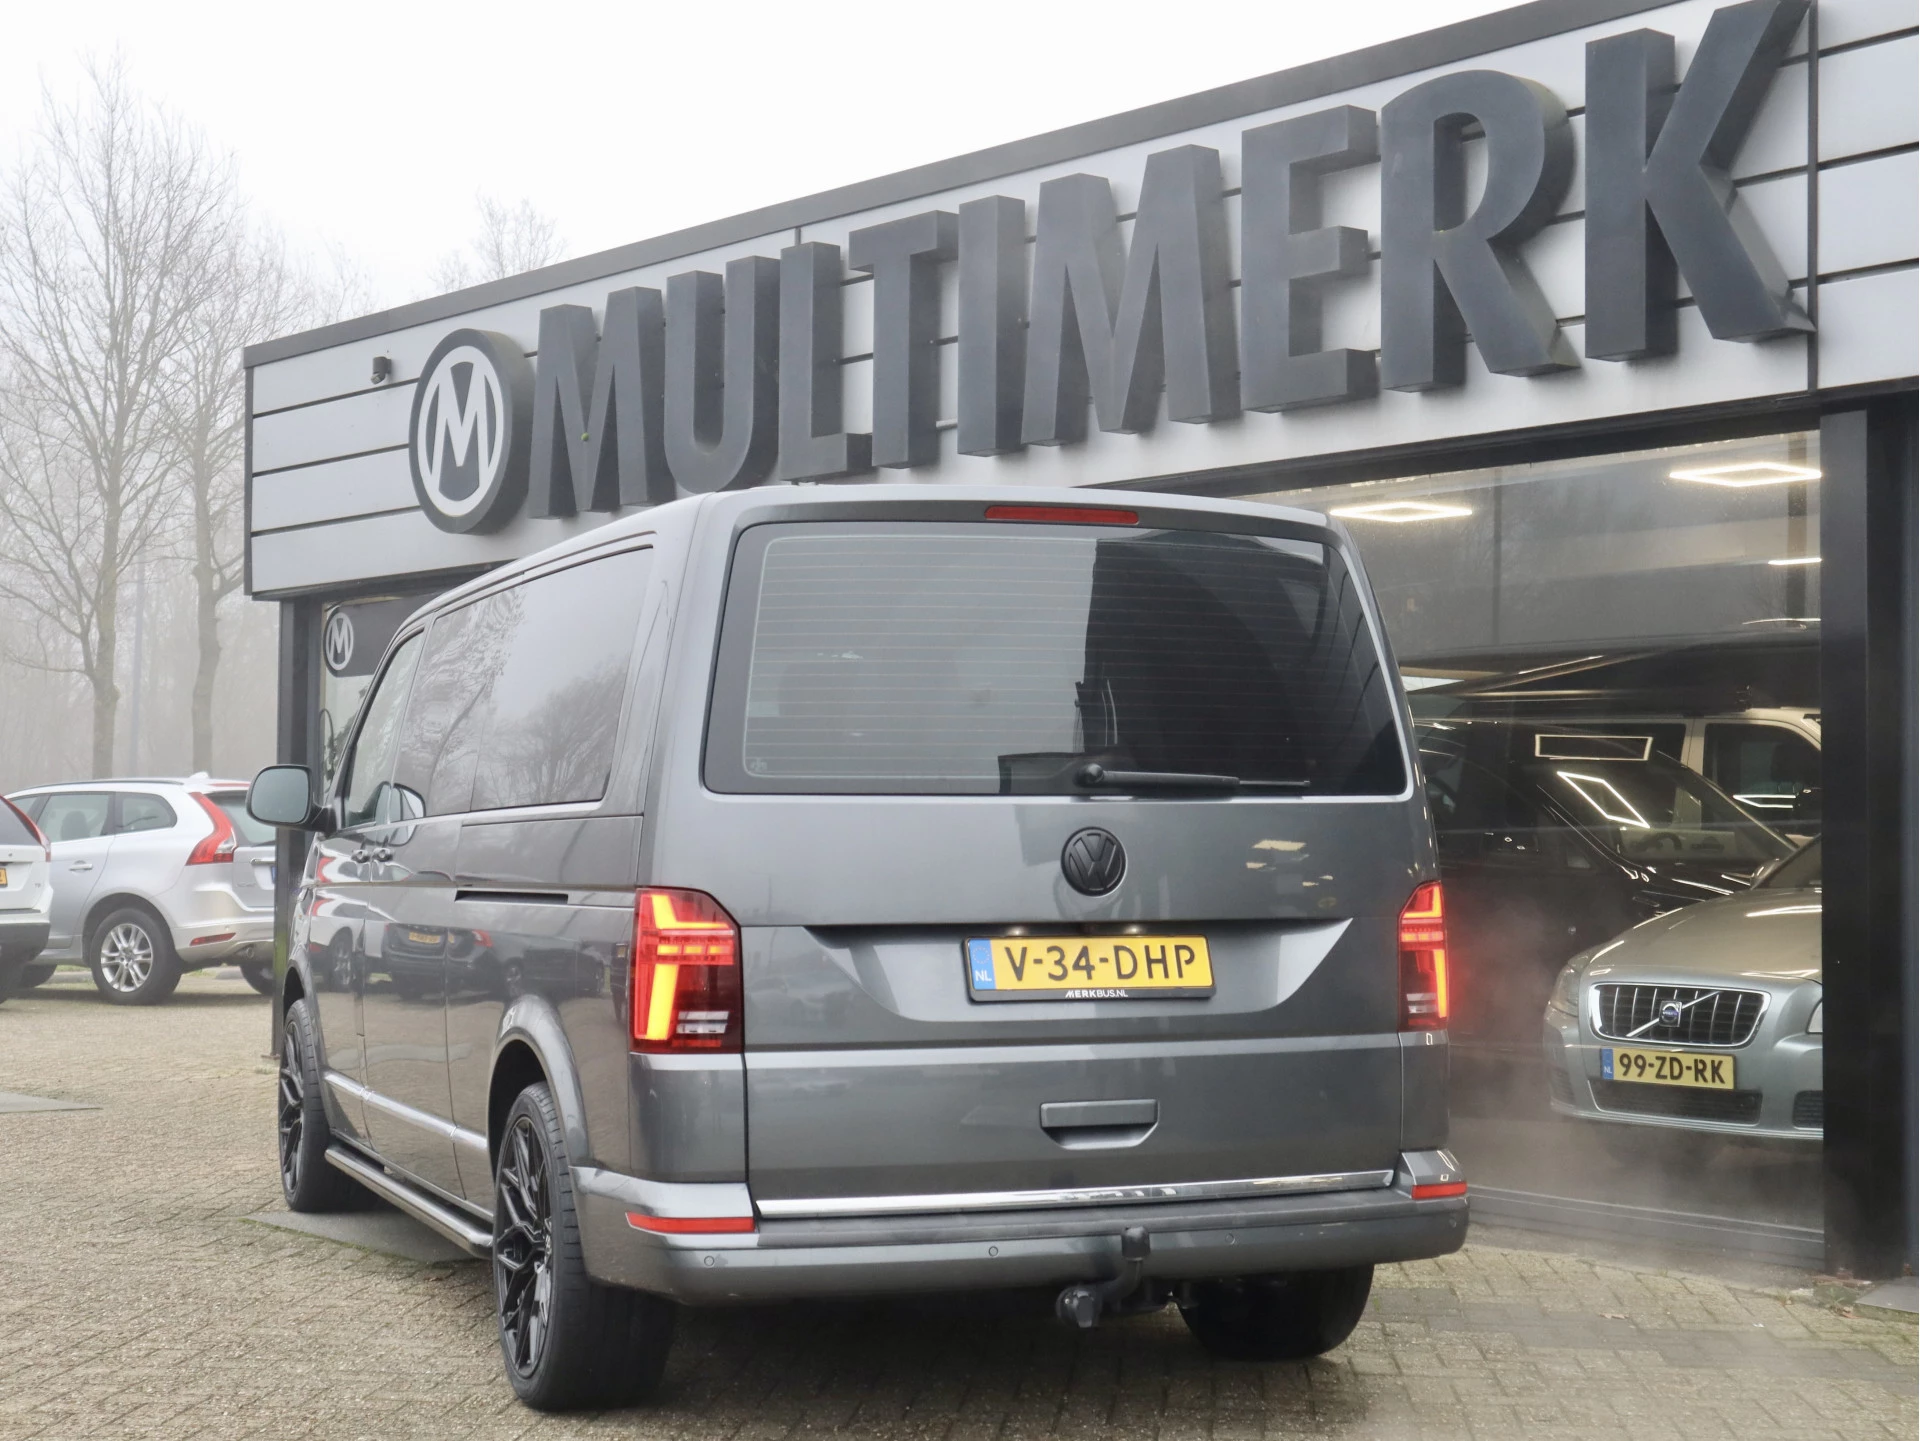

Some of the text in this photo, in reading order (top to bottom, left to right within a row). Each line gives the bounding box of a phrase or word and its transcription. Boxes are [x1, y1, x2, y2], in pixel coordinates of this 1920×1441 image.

[529, 0, 1815, 520] MULTIMERK
[1005, 944, 1195, 981] V-34-DHP
[975, 969, 992, 982] NL
[1065, 988, 1129, 998] MERKBUS.NL
[1603, 1065, 1613, 1074] NL
[1619, 1053, 1726, 1084] 99-ZD-RK
